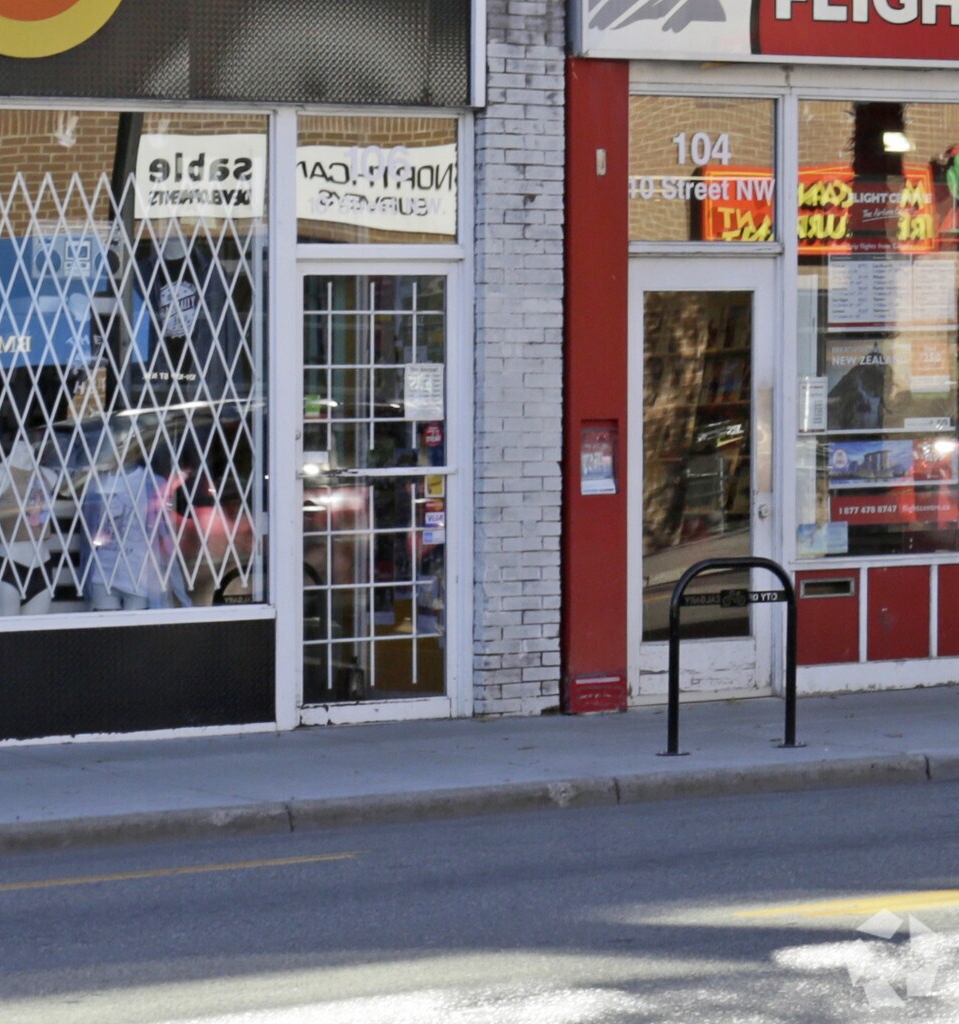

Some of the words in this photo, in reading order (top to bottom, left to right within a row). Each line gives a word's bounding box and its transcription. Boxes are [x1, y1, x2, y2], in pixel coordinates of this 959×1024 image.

[343, 145, 410, 182] 106
[672, 132, 732, 166] 104
[628, 176, 655, 200] 10
[661, 176, 730, 201] Street
[736, 177, 776, 202] NW
[831, 355, 856, 366] NEW
